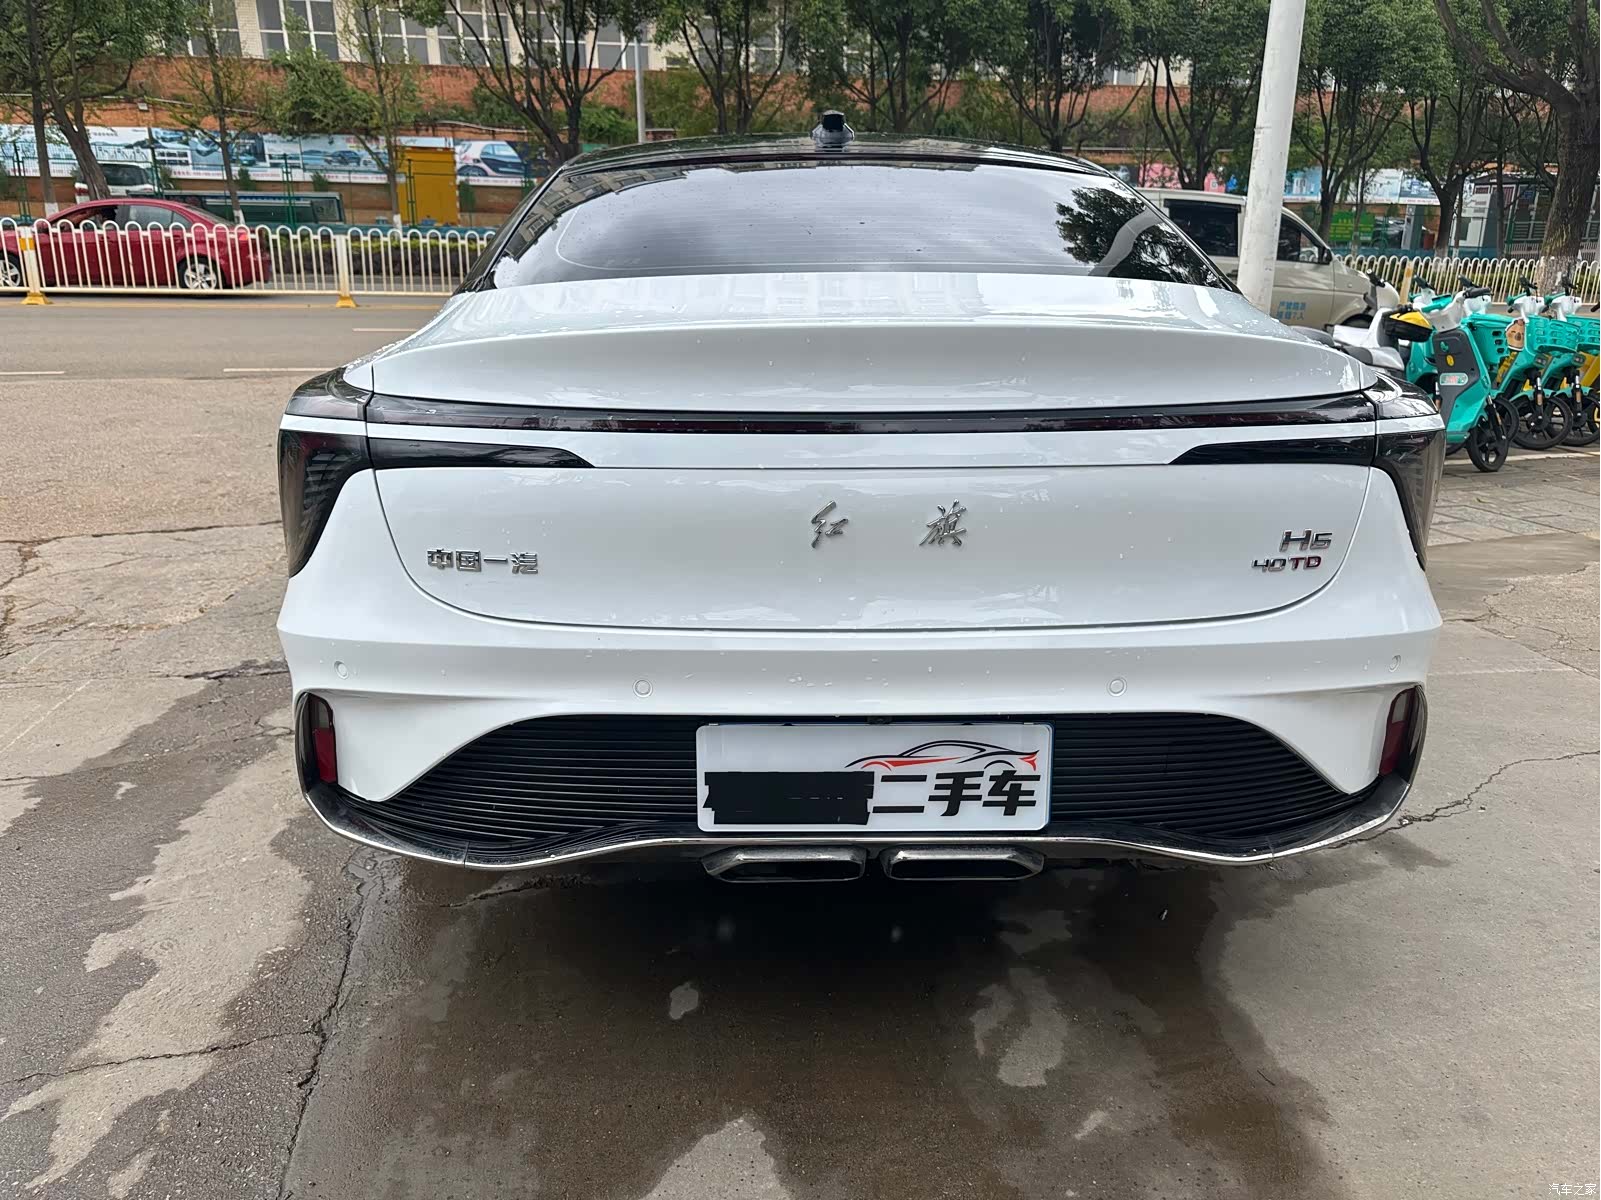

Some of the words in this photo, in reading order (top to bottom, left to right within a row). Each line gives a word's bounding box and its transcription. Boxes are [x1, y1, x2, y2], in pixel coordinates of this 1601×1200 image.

[426, 548, 538, 574] 中国一汽
[1251, 556, 1322, 572] 40TD
[872, 769, 1041, 818] 二手车
